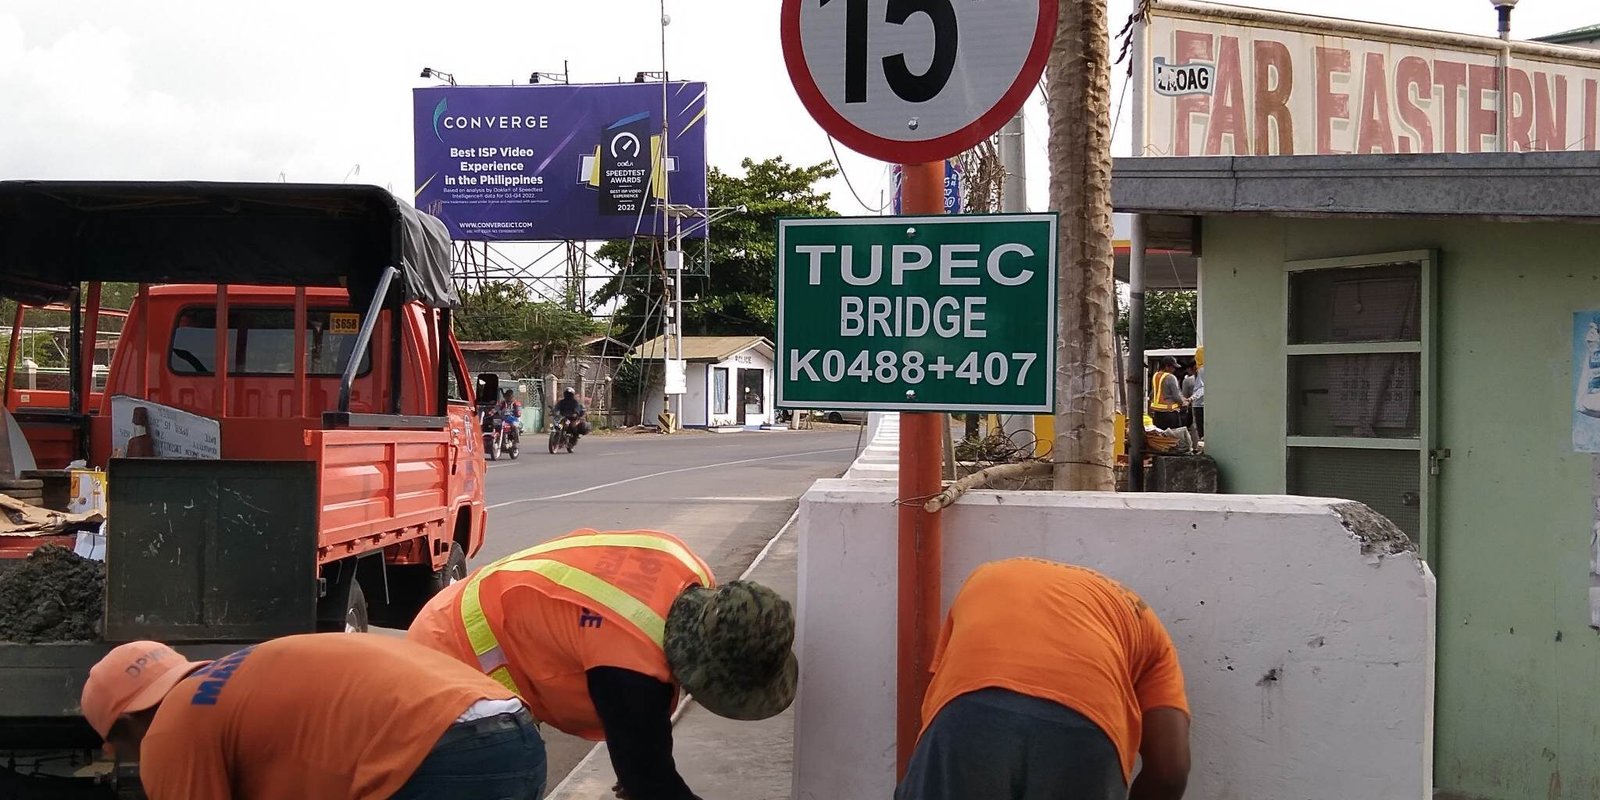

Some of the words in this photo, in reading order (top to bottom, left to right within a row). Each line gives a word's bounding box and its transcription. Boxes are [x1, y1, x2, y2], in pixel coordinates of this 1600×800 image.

[819, 0, 959, 104] 15
[1174, 30, 1294, 156] FAR
[1315, 46, 1568, 153] EASTERN
[443, 116, 549, 129] CONVERGE
[450, 147, 476, 157] Best
[478, 147, 497, 157] ISP
[499, 146, 534, 157] Video
[460, 161, 524, 173] Experience
[444, 175, 456, 185] in
[458, 174, 478, 185] the
[480, 174, 544, 187] Philippines
[795, 243, 1035, 286] TUPEC
[335, 319, 357, 330] S658
[840, 296, 987, 338] BRIDGE
[790, 348, 1037, 386] K0488+407
